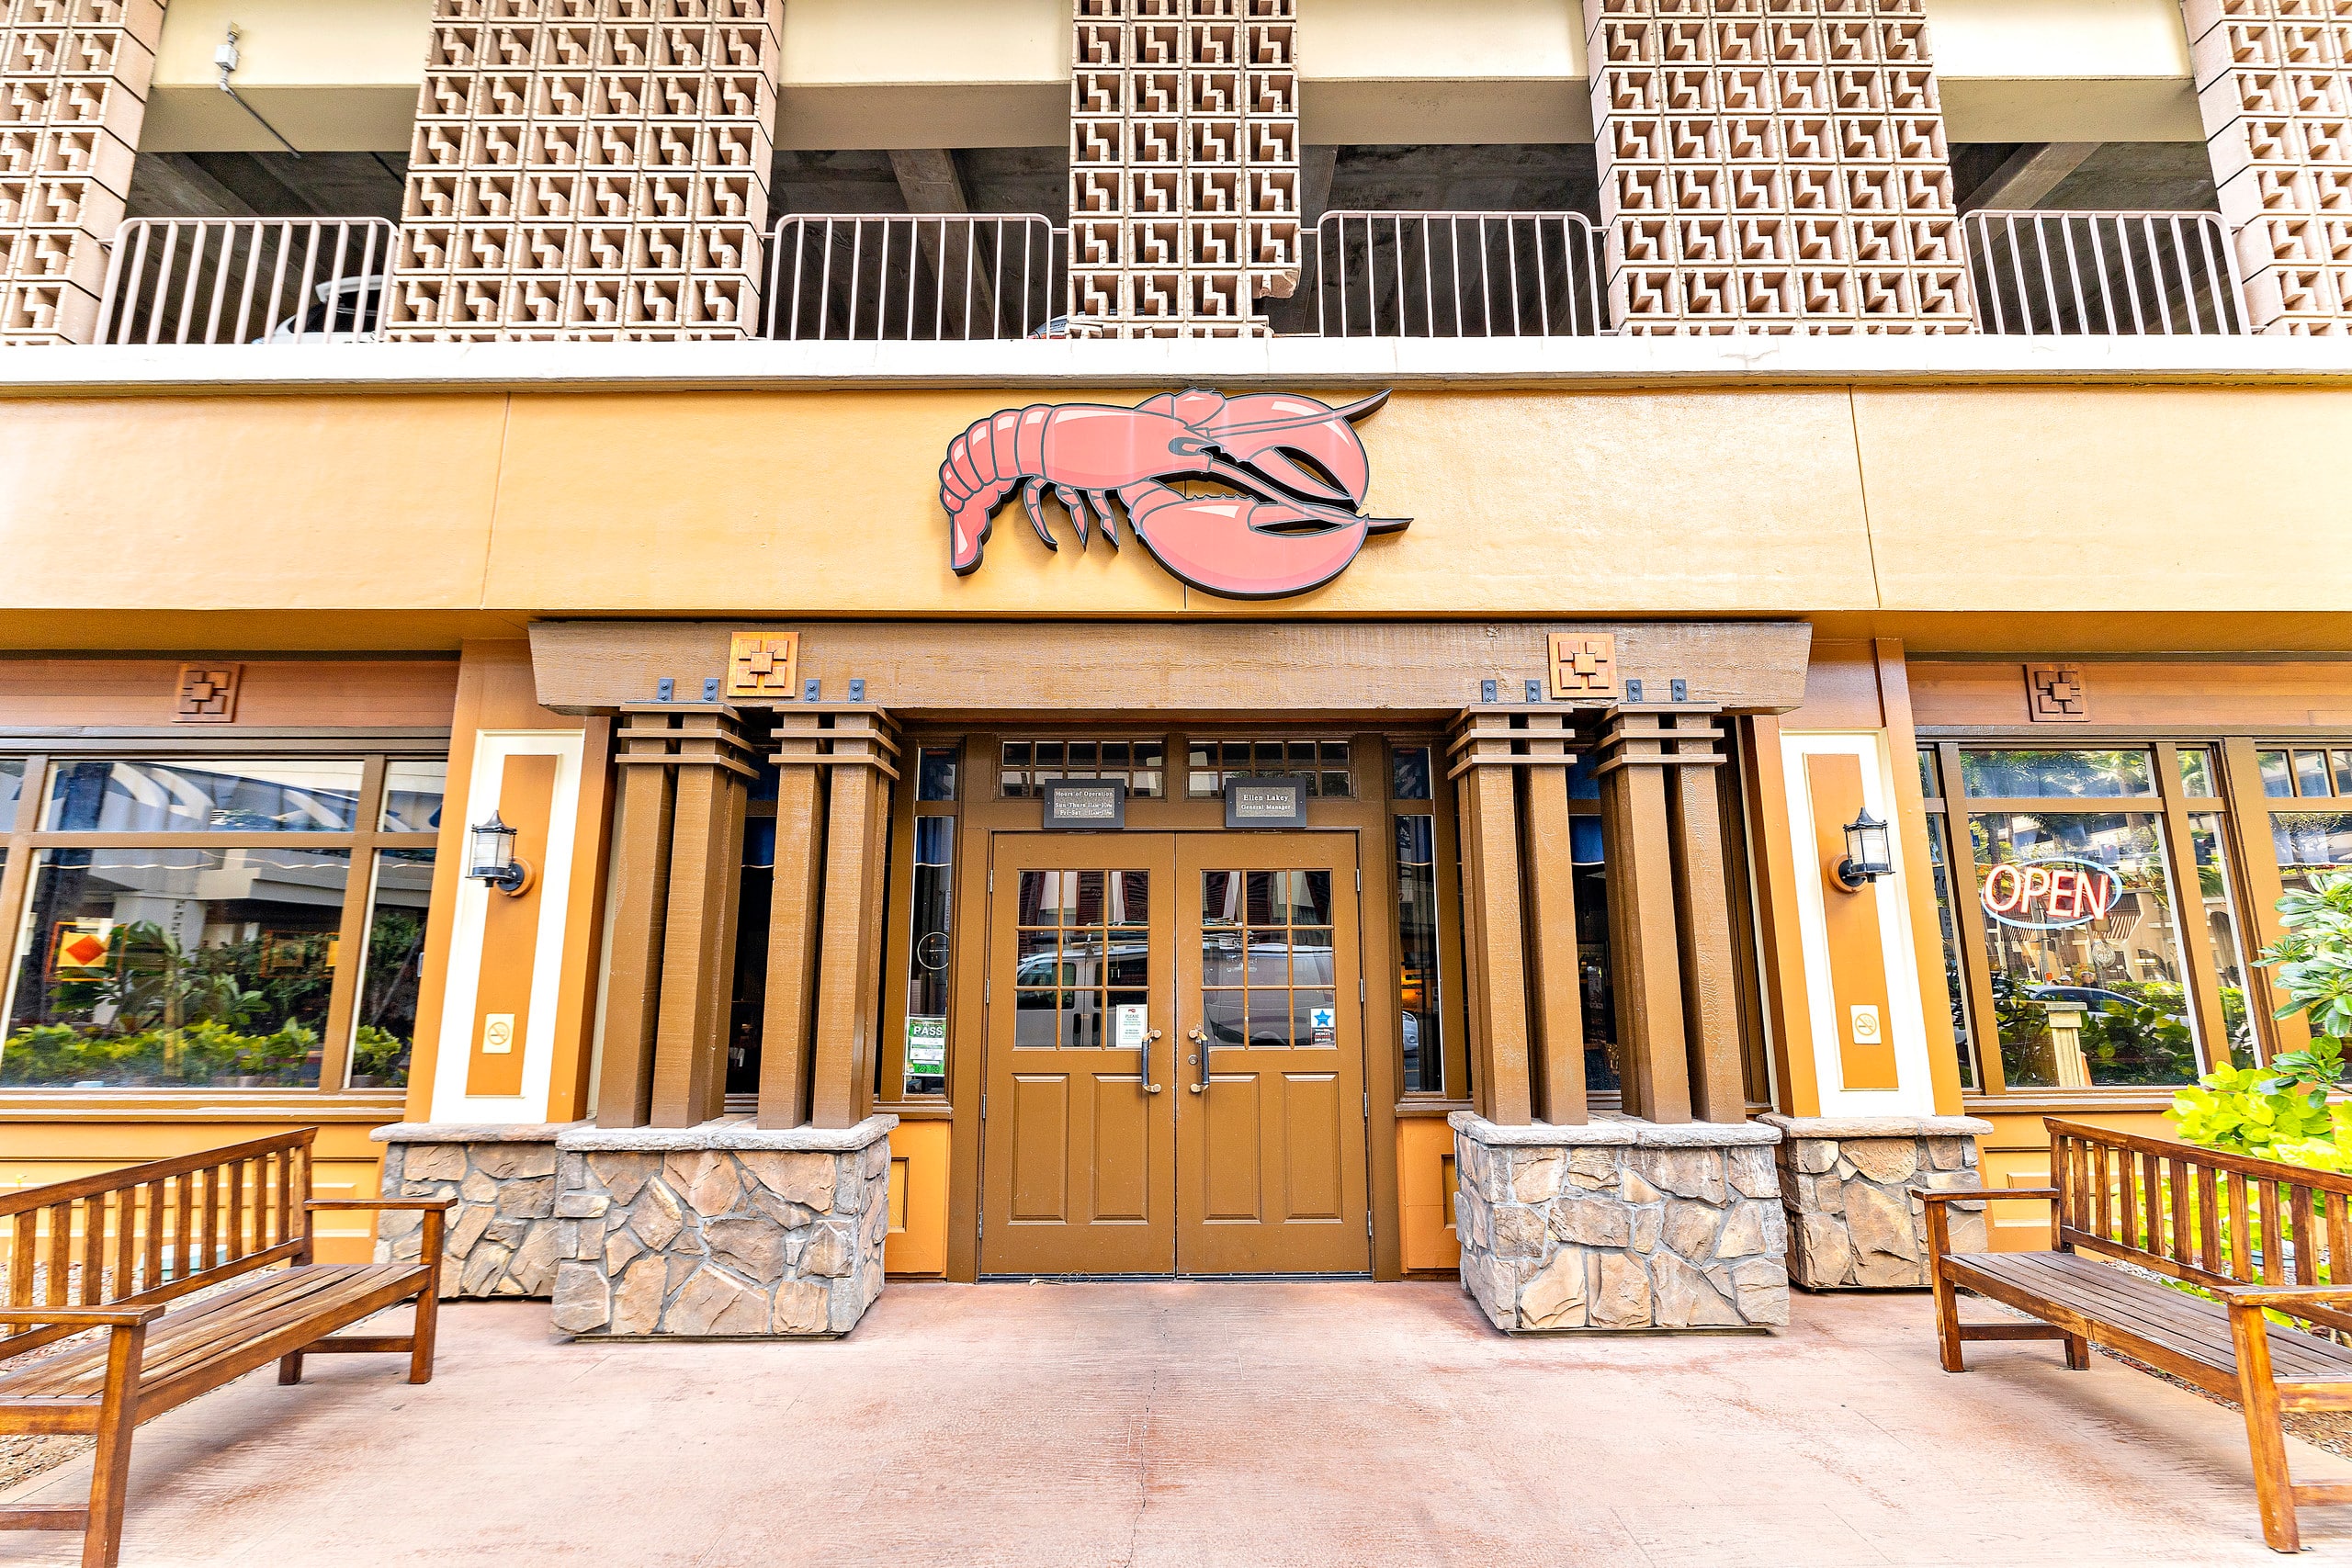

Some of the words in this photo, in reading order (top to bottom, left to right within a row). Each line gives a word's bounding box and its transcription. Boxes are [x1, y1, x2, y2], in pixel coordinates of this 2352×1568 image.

[1266, 794, 1288, 802] Lakey
[1984, 863, 2109, 920] OPEN
[913, 1026, 944, 1036] PASS
